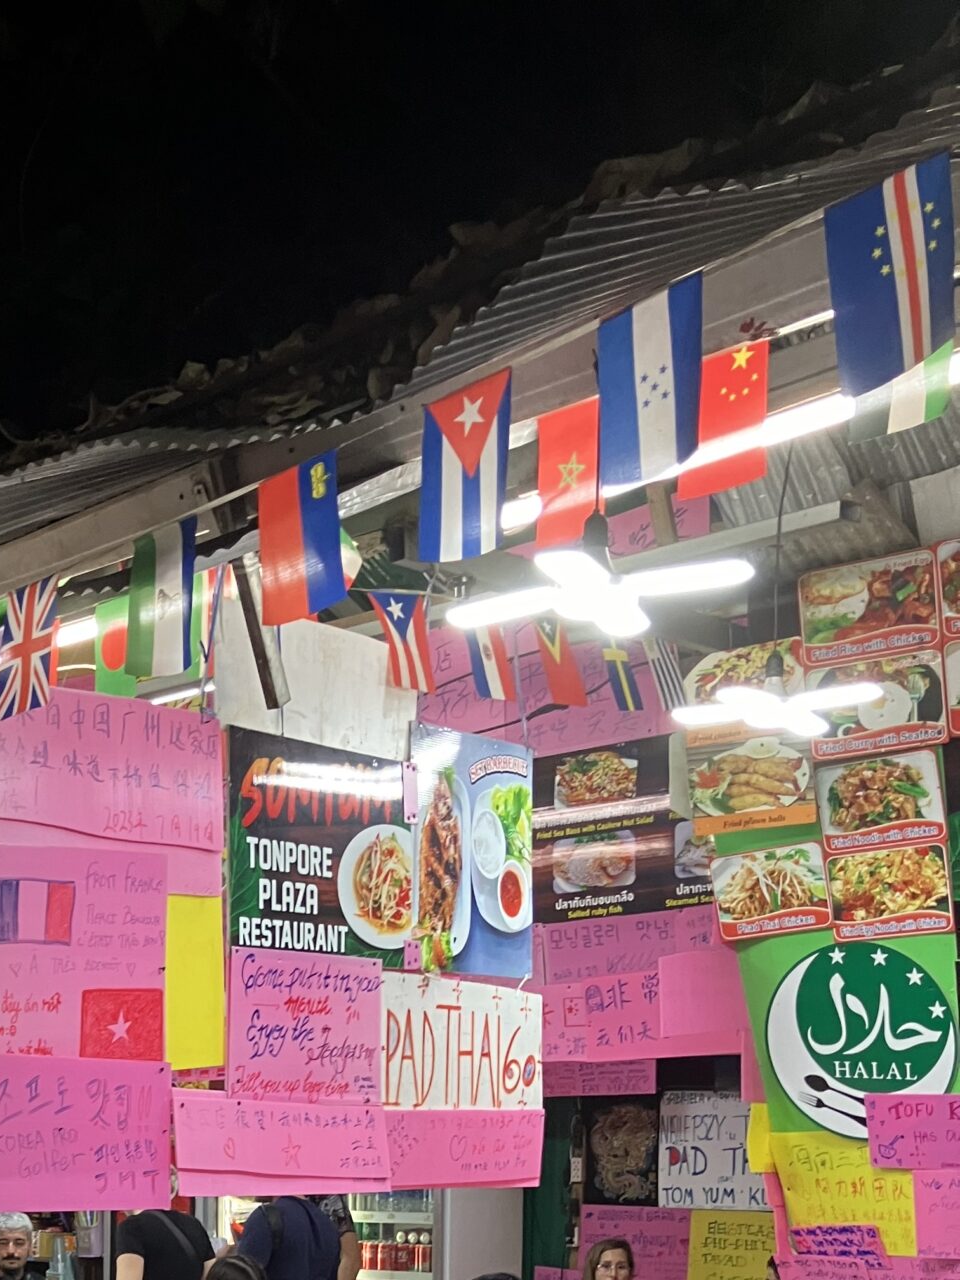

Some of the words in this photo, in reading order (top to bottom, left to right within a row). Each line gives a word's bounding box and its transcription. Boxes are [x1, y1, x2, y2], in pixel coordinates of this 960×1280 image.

[812, 647, 837, 661] Fried
[840, 644, 862, 657] Rice
[863, 639, 886, 652] with
[888, 632, 931, 648] Chicken
[819, 742, 844, 754] Fried
[846, 737, 875, 751] Curry
[877, 733, 899, 746] with
[900, 727, 944, 741] Seafood
[536, 828, 552, 840] Fried
[582, 823, 596, 833] with
[623, 817, 635, 827] Nut
[636, 814, 655, 825] Salad
[831, 837, 853, 848] Fried
[855, 833, 883, 845] Noodle
[885, 830, 902, 841] with
[902, 826, 939, 838] Chicken
[246, 836, 334, 878] TONPORE
[258, 878, 319, 915] PLAZA
[665, 895, 699, 908] Steamed
[567, 906, 591, 919] Salted
[609, 903, 623, 914] fish
[238, 916, 349, 954] RESTAURANT
[737, 921, 759, 933] Phad
[761, 919, 780, 930] Thai
[782, 915, 815, 927] Chicken
[840, 926, 858, 937] Fried
[859, 924, 873, 936] Egg
[874, 922, 899, 934] Noodle
[900, 920, 916, 930] with
[917, 918, 946, 929] Chicken
[807, 972, 943, 1055] حلال
[382, 1008, 435, 1108] PAD
[436, 1004, 502, 1109] THAI
[503, 1025, 537, 1095] 60
[833, 1060, 918, 1081] HALAL
[888, 1101, 934, 1120] TOFU
[51, 1127, 79, 1147] PRO
[913, 1130, 937, 1144] HAS
[18, 1151, 86, 1180] Golfer
[665, 1145, 707, 1176] PAD
[662, 1186, 694, 1206] TOM
[702, 1186, 735, 1205] YUM
